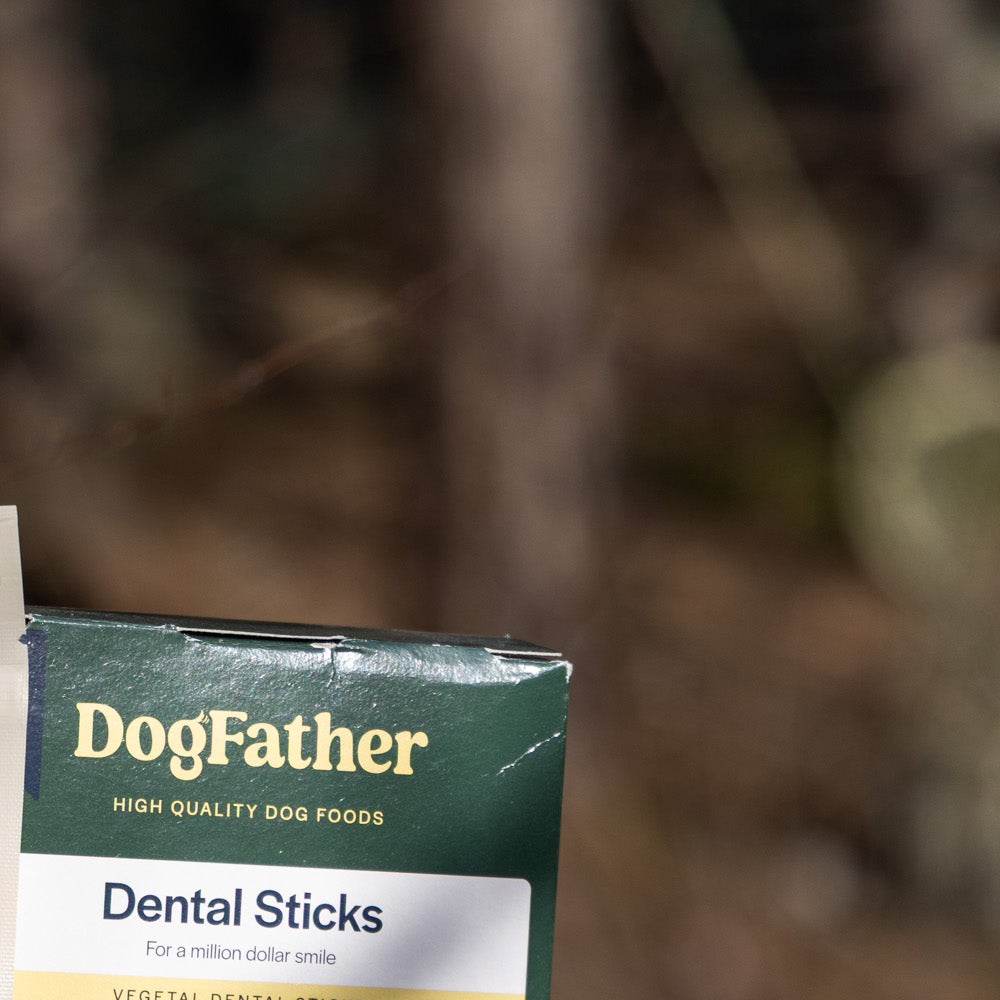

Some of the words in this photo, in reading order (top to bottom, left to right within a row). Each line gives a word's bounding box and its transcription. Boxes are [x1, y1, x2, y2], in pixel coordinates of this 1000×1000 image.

[73, 702, 430, 781] DogFather
[113, 797, 163, 814] HIGH
[170, 800, 258, 819] QUALITY
[265, 804, 309, 822] DOG
[316, 808, 385, 826] FOODS
[103, 881, 243, 926] Dental
[254, 889, 384, 934] Sticks
[146, 940, 173, 957] For
[176, 946, 186, 958] a
[191, 944, 242, 960] million
[246, 946, 290, 963] dollar
[295, 949, 337, 965] smile
